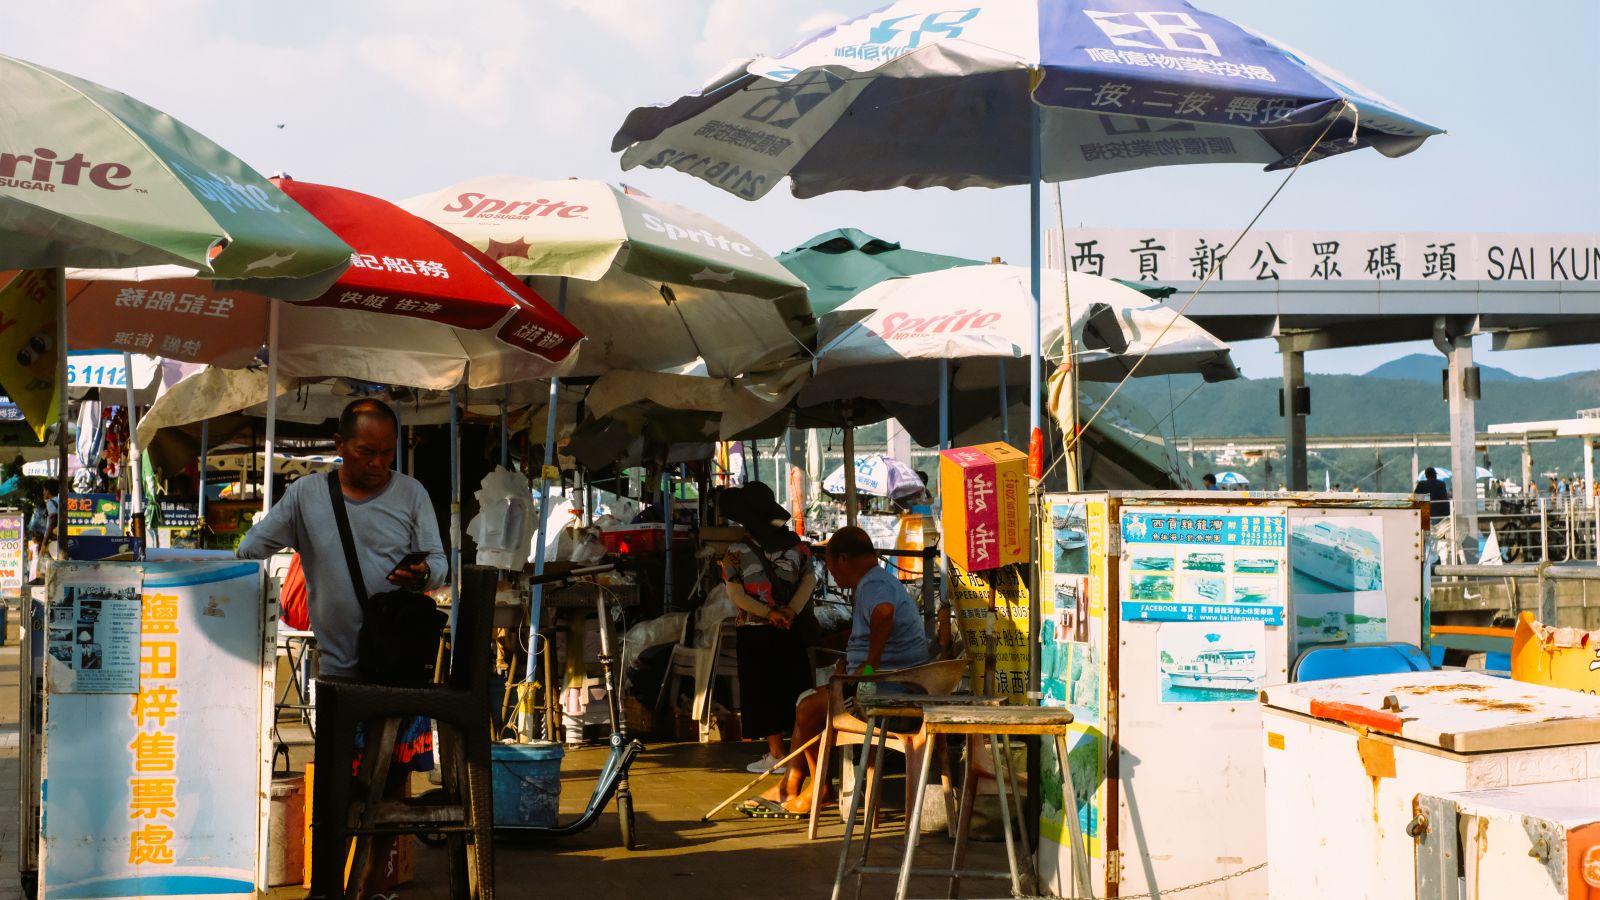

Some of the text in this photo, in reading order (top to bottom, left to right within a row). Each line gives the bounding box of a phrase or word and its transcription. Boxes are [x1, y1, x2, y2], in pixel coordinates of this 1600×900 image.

[1085, 48, 1277, 82] 順億物業按揭
[443, 192, 589, 218] Sprite
[641, 213, 754, 257] Sprite
[1071, 238, 1457, 281] 西貢新公眾碼頭
[1488, 246, 1535, 280] SAI
[865, 309, 1001, 340] Sprite
[974, 473, 994, 513] vita
[976, 523, 996, 562] vita
[1141, 604, 1177, 612] FACEBOOK
[128, 593, 180, 865] 鹽田梓售票處
